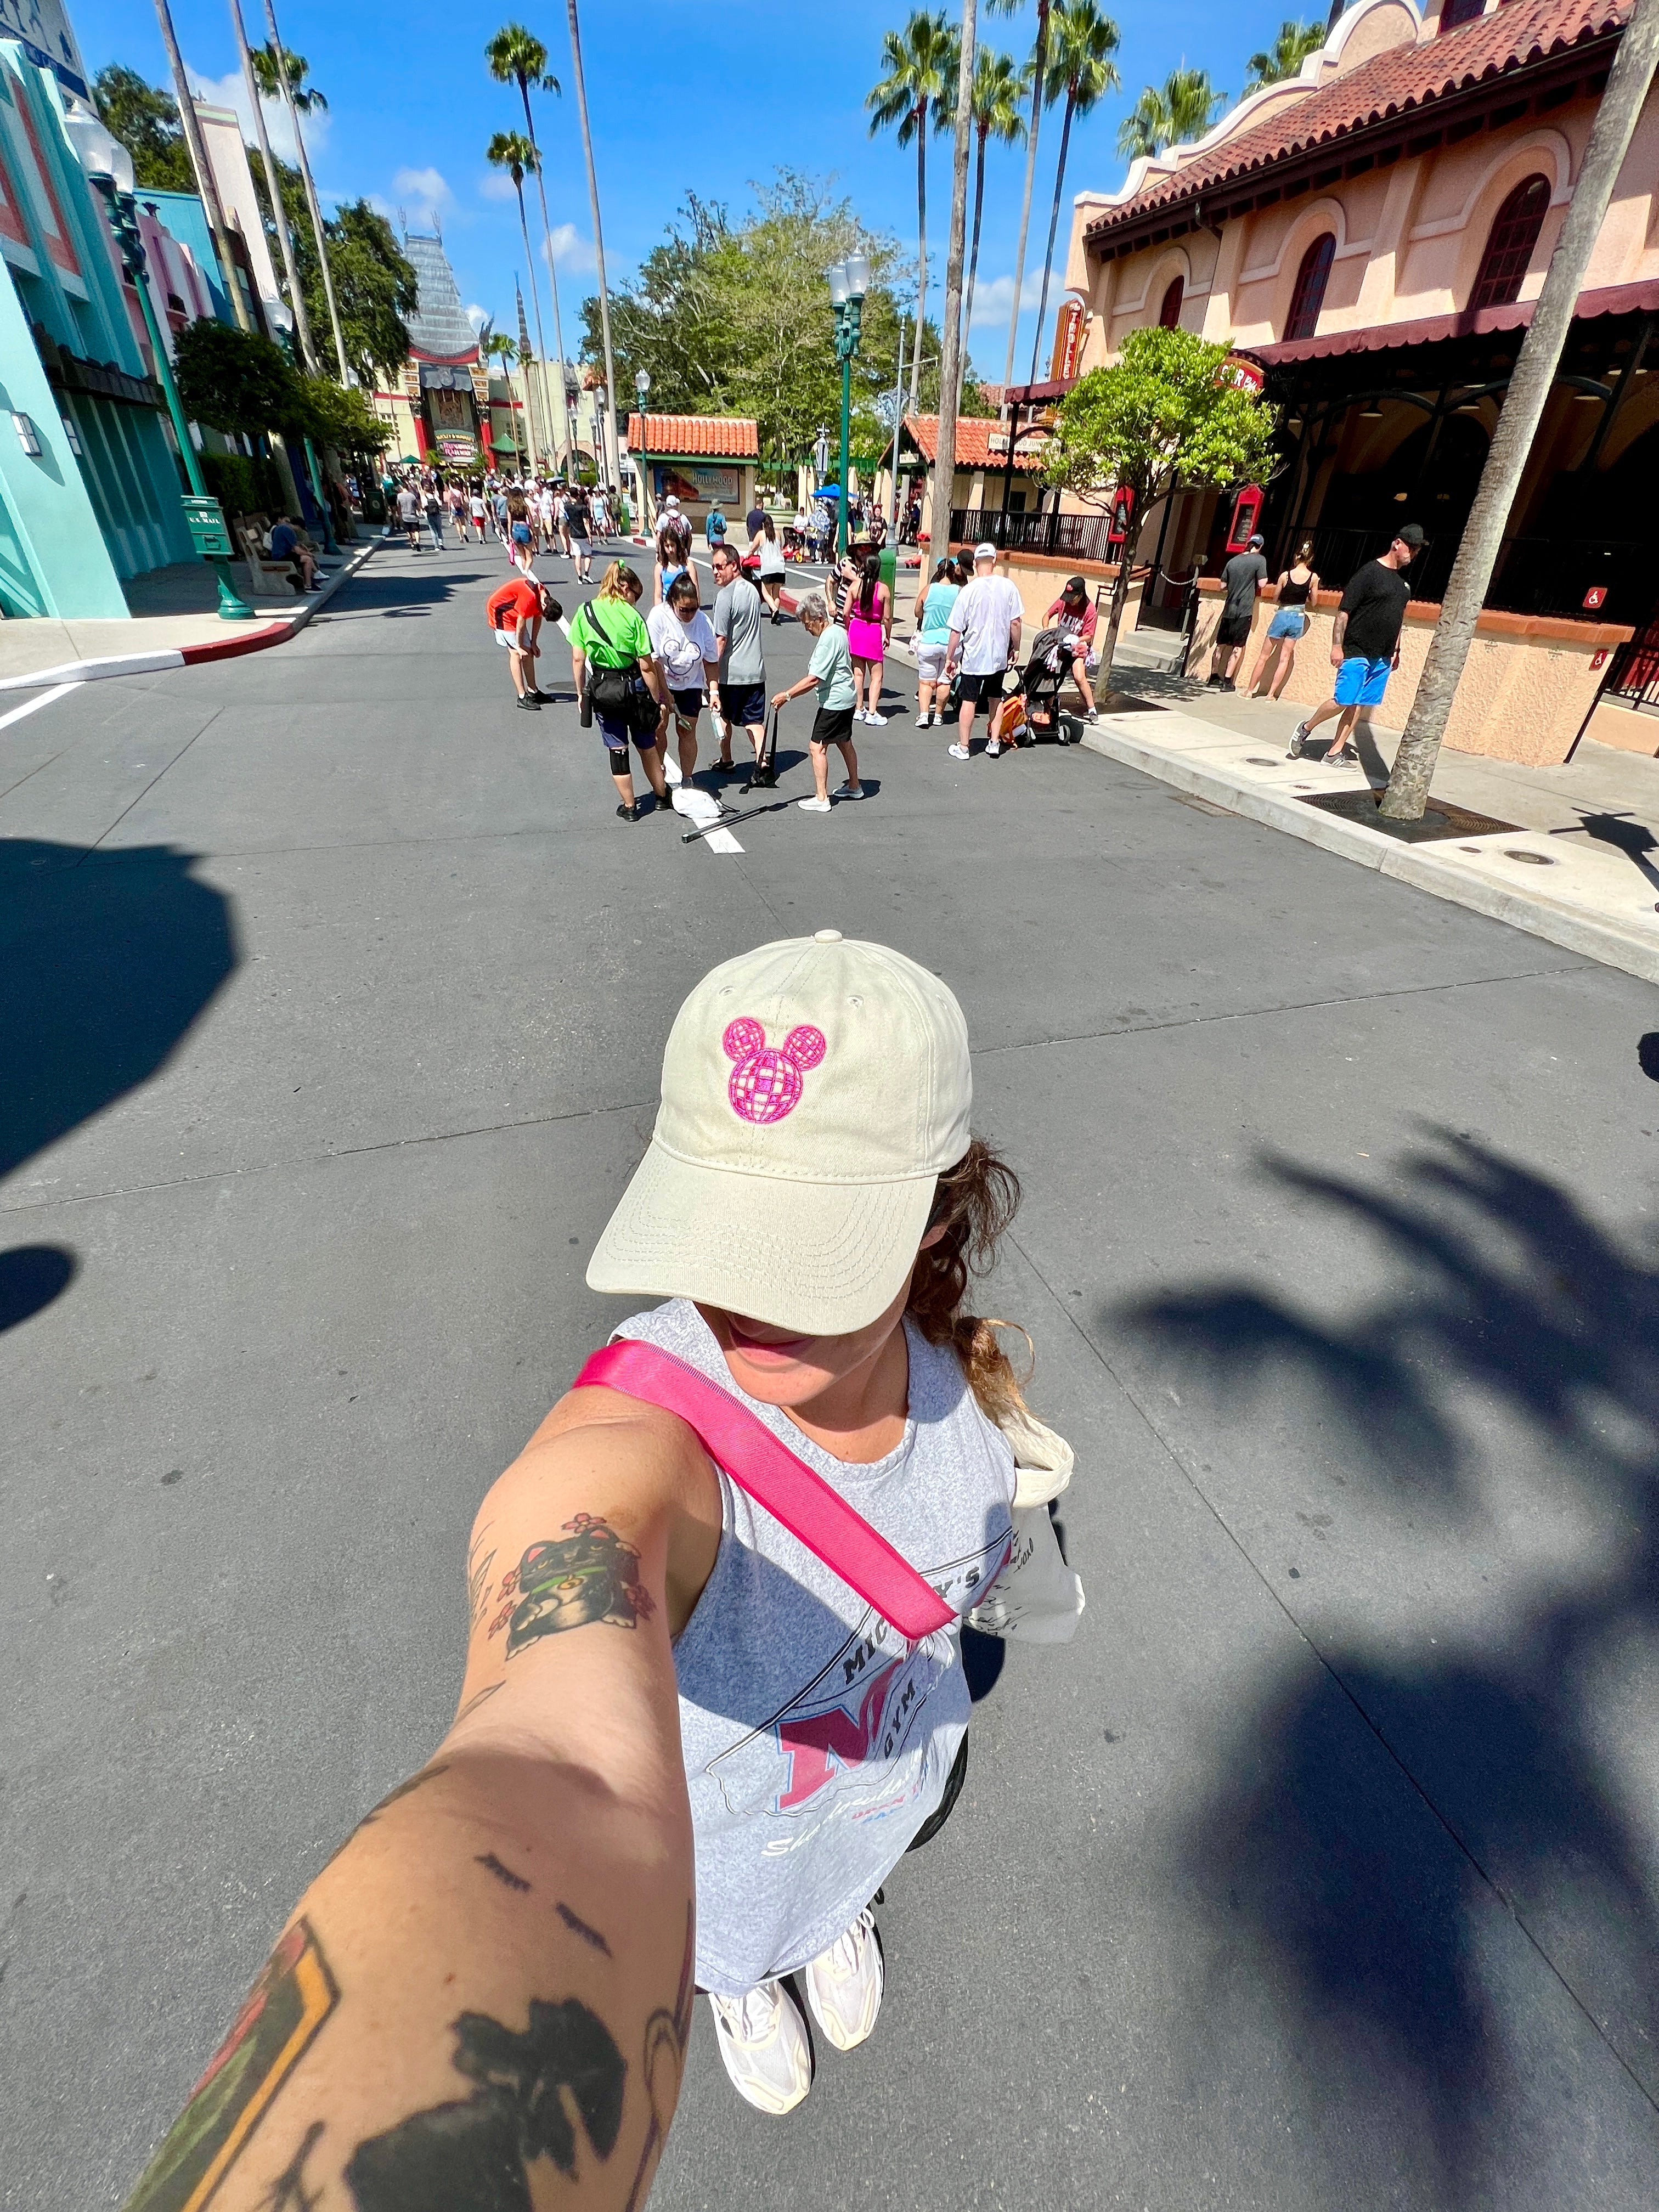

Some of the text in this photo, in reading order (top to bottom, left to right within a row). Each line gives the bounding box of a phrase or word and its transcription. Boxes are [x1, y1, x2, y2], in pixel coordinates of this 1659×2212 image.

[692, 472, 733, 486] HOLLYWOOD
[843, 1566, 980, 1685] MICY'S
[884, 1679, 915, 1759] GYM
